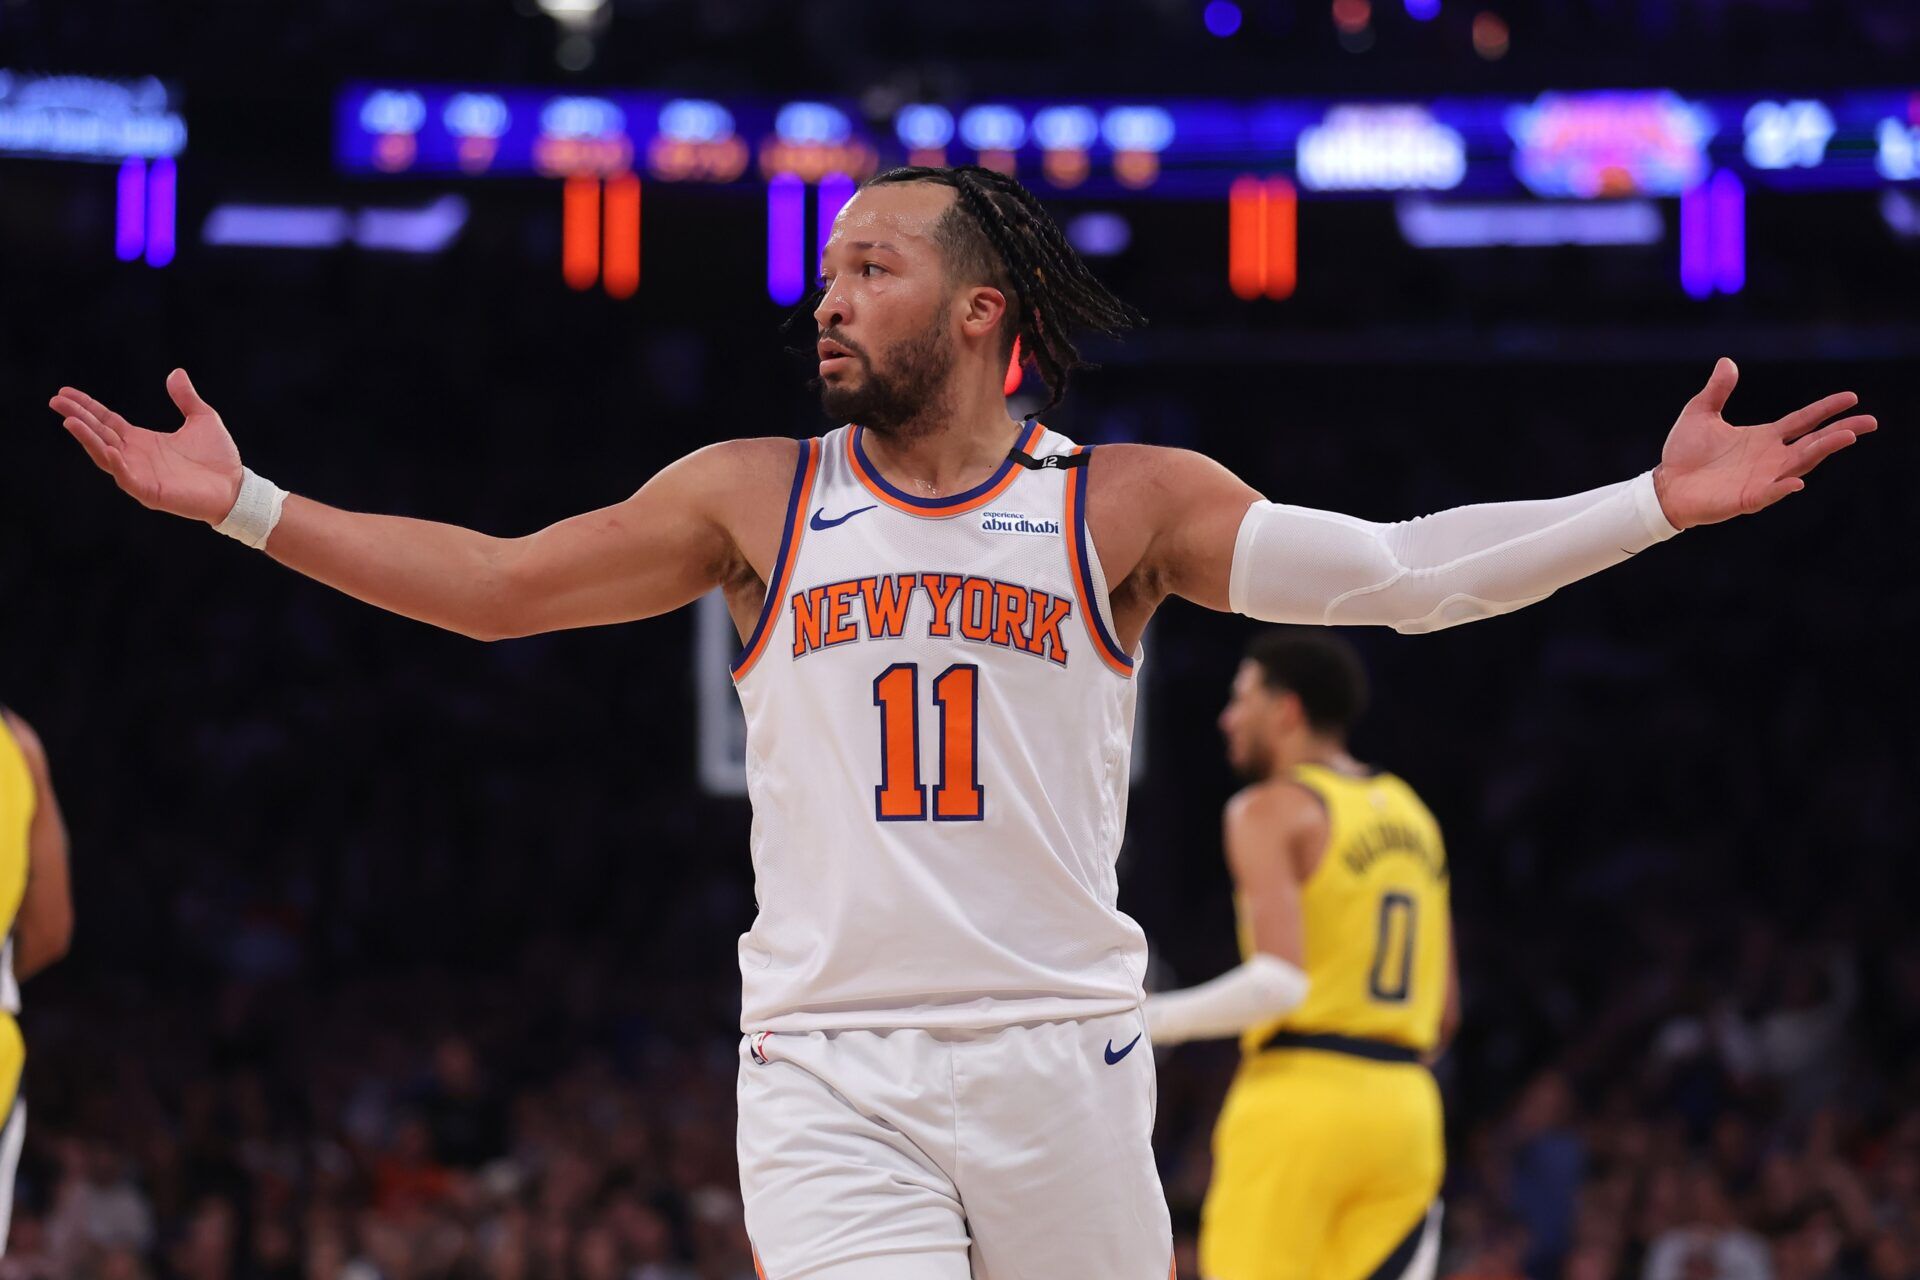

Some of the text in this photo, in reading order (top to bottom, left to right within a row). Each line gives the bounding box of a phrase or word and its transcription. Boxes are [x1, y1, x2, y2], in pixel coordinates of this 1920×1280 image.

[1041, 456, 1058, 468] 12
[982, 518, 1059, 534] abu dhabi
[983, 511, 1024, 519] experience
[791, 571, 1074, 668] NEW YORK
[873, 662, 984, 821] 11
[1368, 891, 1416, 1002] 0
